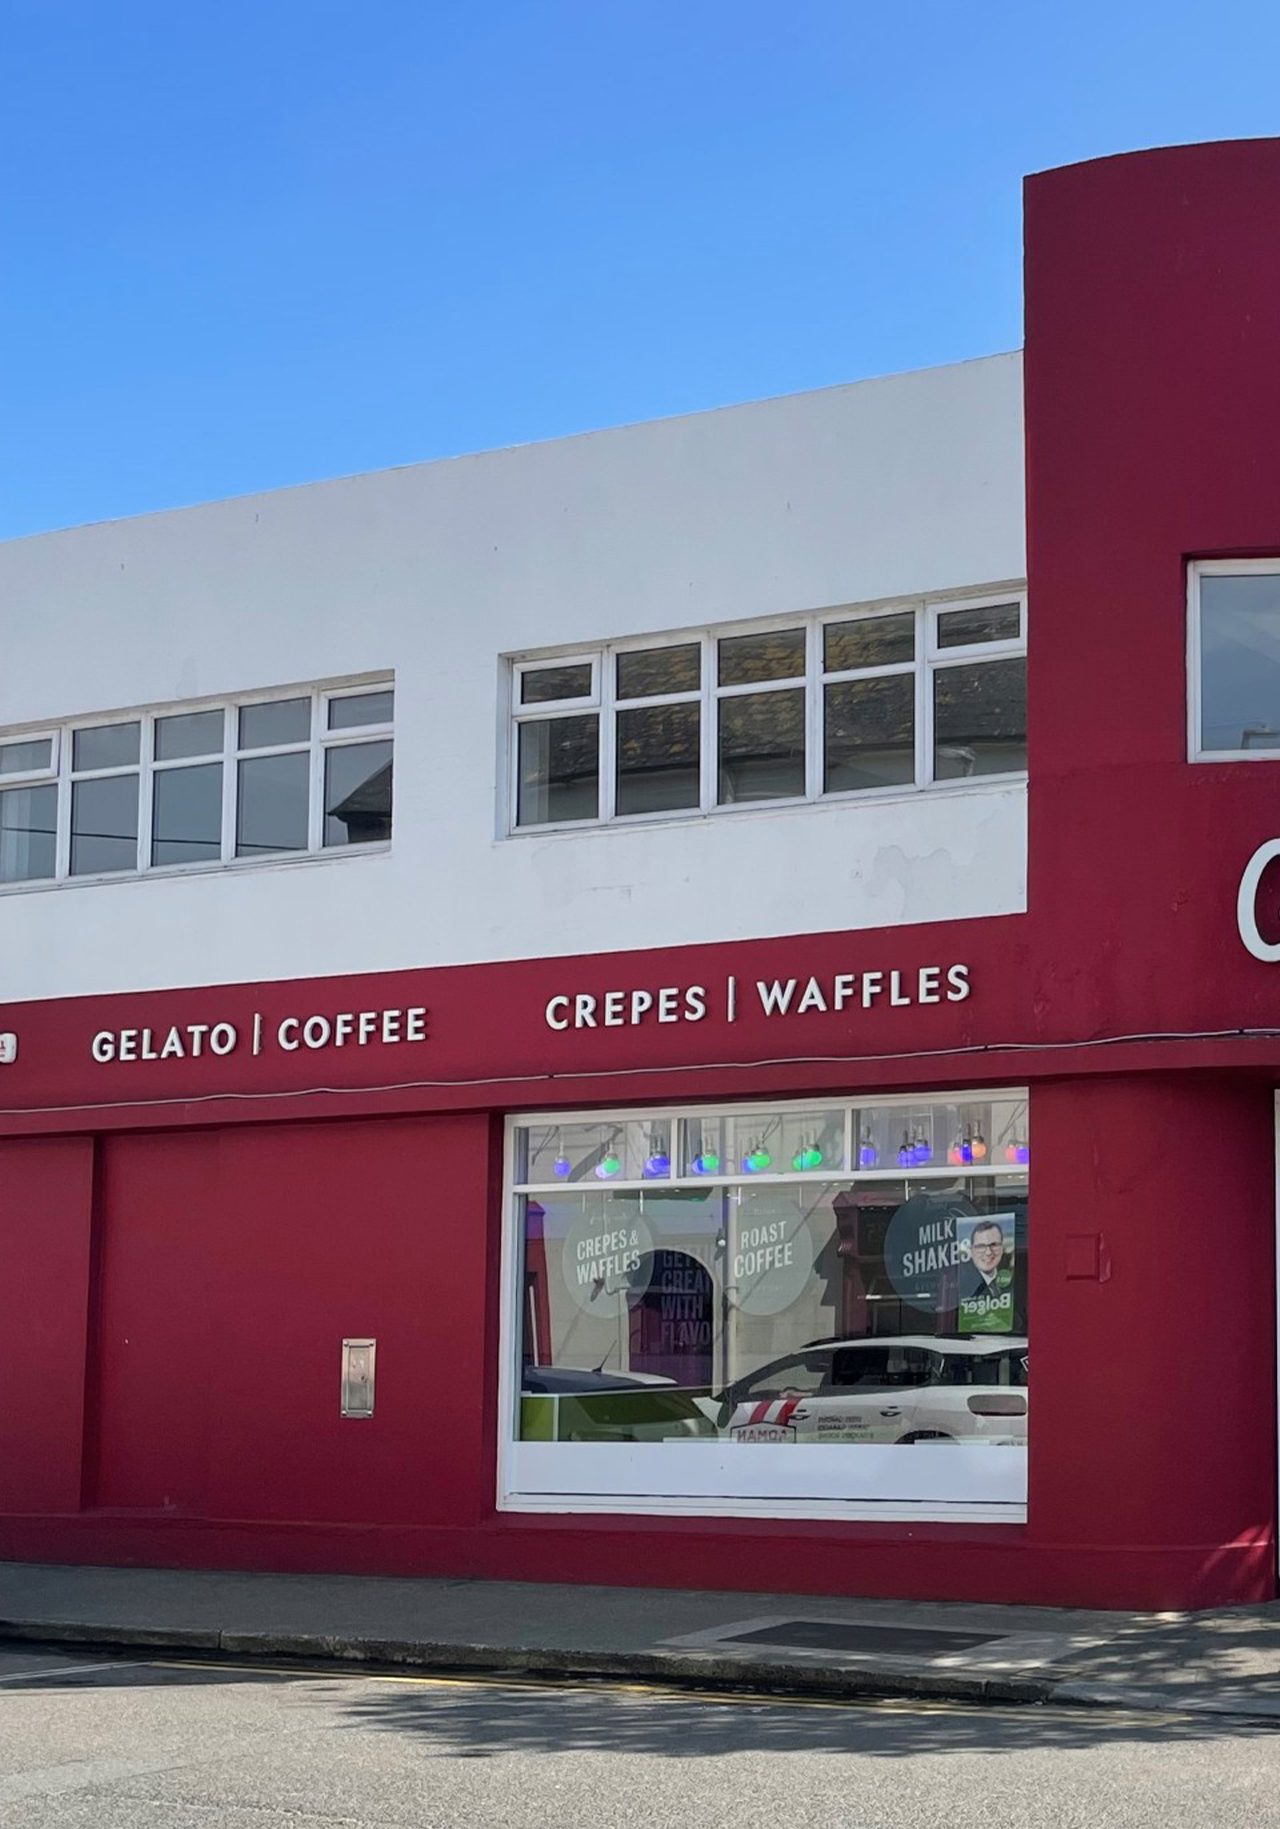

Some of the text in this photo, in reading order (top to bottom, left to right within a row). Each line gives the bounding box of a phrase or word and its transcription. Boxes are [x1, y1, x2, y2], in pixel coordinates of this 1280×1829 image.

[545, 964, 971, 1030] CREPES WAFFLES
[92, 1007, 427, 1063] GELATO COFFEE
[576, 1229, 639, 1260] CREPES &
[741, 1221, 787, 1250] ROAST
[919, 1219, 954, 1245] MILK
[576, 1250, 641, 1285] WAFFLES
[734, 1242, 793, 1278] COFFEE
[902, 1238, 972, 1277] SHAKES
[660, 1296, 703, 1320] WITH
